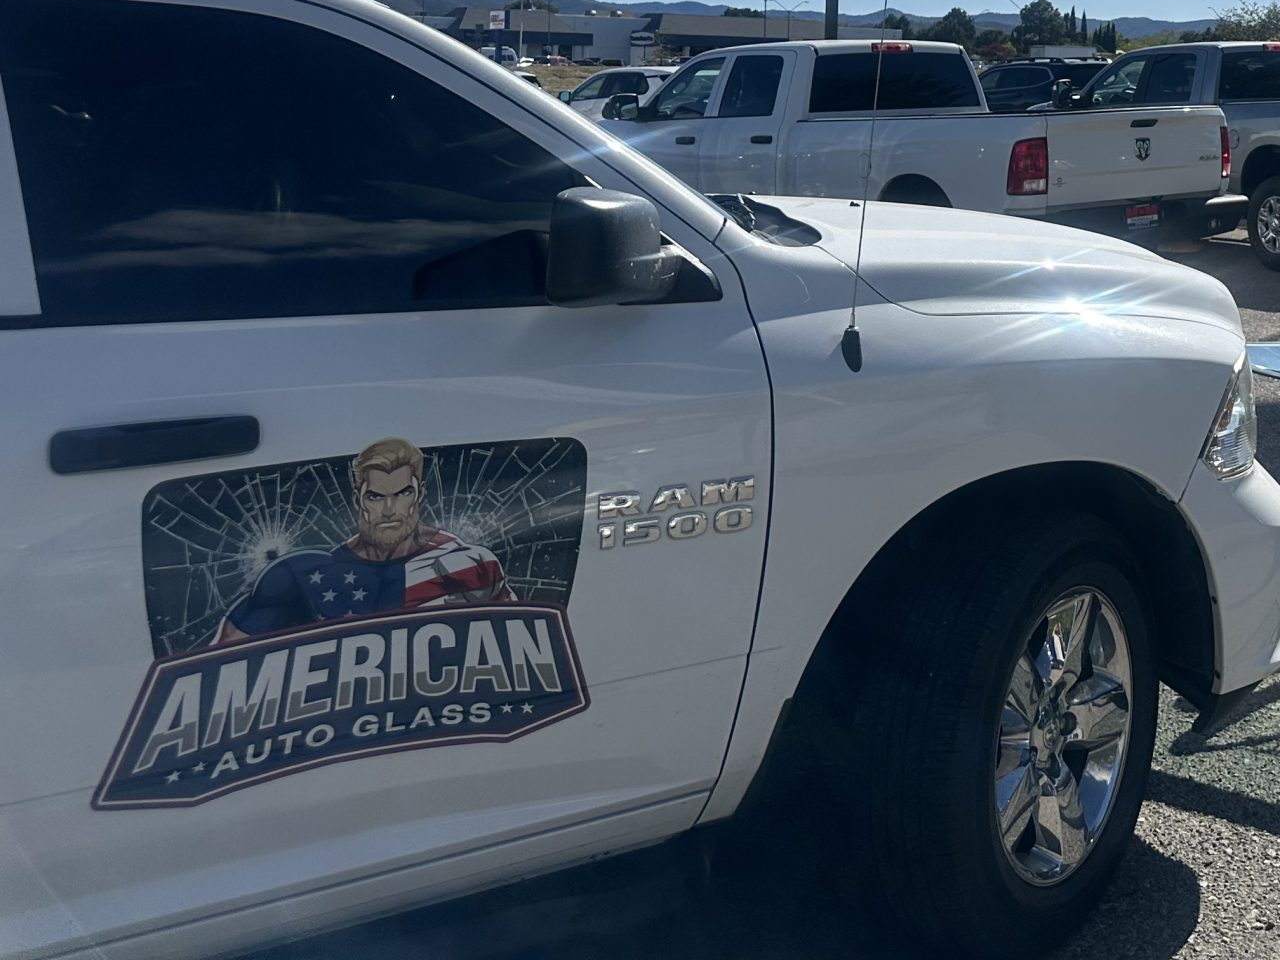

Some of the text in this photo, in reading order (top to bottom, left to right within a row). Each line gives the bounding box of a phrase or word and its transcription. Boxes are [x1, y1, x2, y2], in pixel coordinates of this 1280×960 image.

[598, 476, 755, 518] RAM
[598, 505, 753, 550] 1500
[131, 617, 563, 774] AMERICAN
[209, 700, 492, 779] AUTO GLASS
